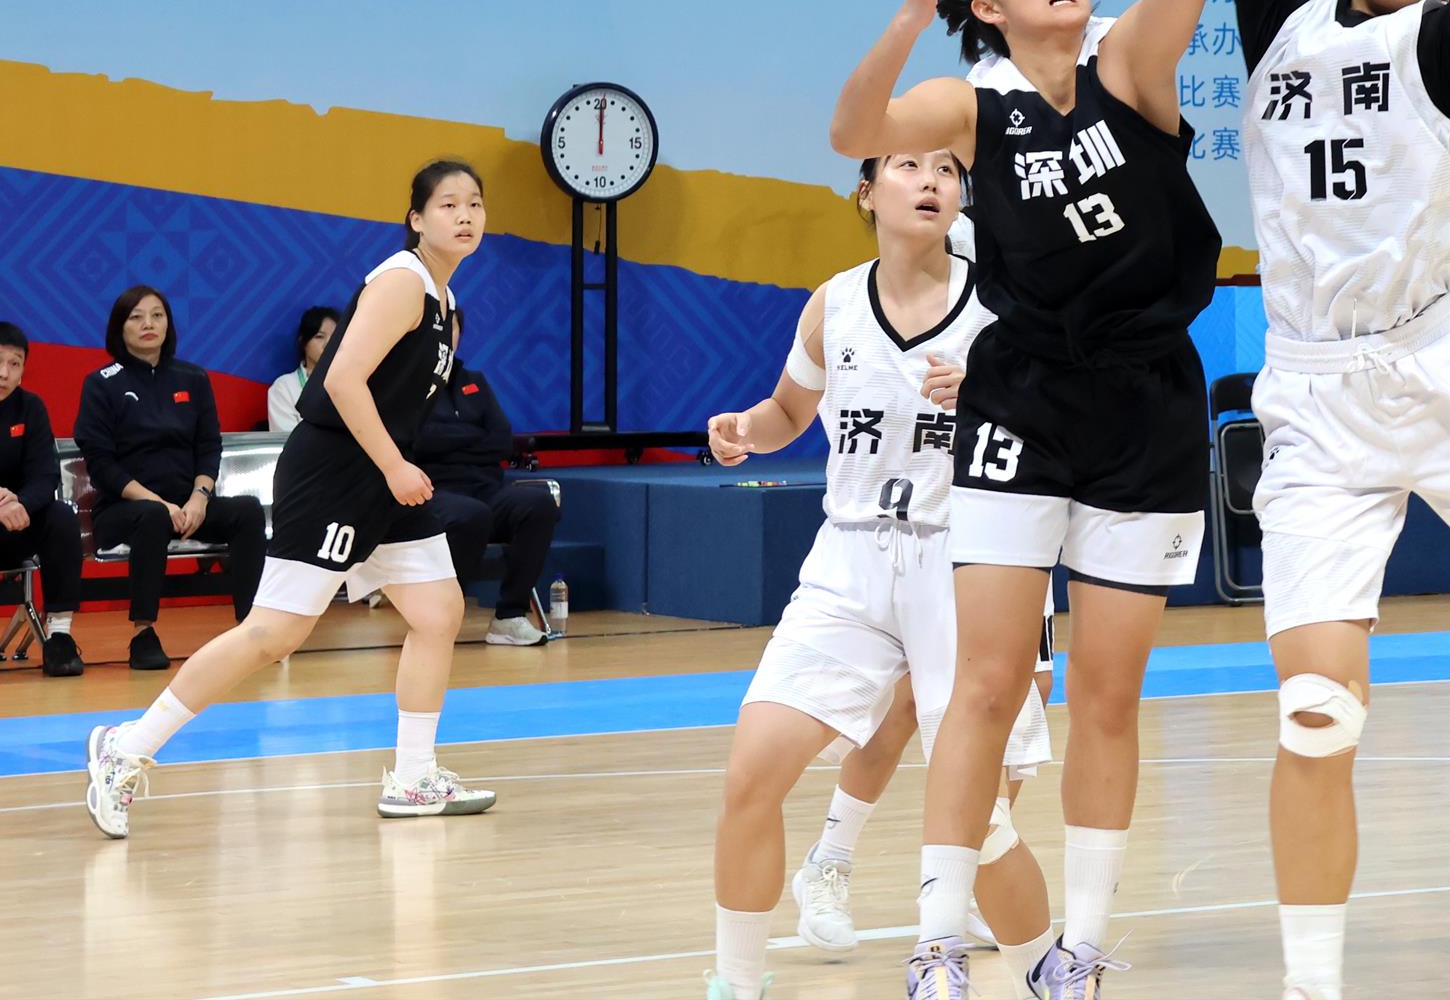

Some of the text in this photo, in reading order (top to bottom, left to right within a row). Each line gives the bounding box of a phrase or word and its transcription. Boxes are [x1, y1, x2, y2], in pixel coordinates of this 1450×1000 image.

[593, 98, 607, 110] 20
[1262, 61, 1392, 121] 济南
[558, 136, 642, 149] 5 15
[1014, 119, 1127, 201] 深圳
[594, 176, 607, 188] 10
[1304, 138, 1368, 201] 15
[1063, 192, 1126, 243] 13
[838, 408, 957, 456] 济南
[968, 421, 1025, 483] 13
[878, 478, 914, 522] 9
[317, 521, 356, 563] 10
